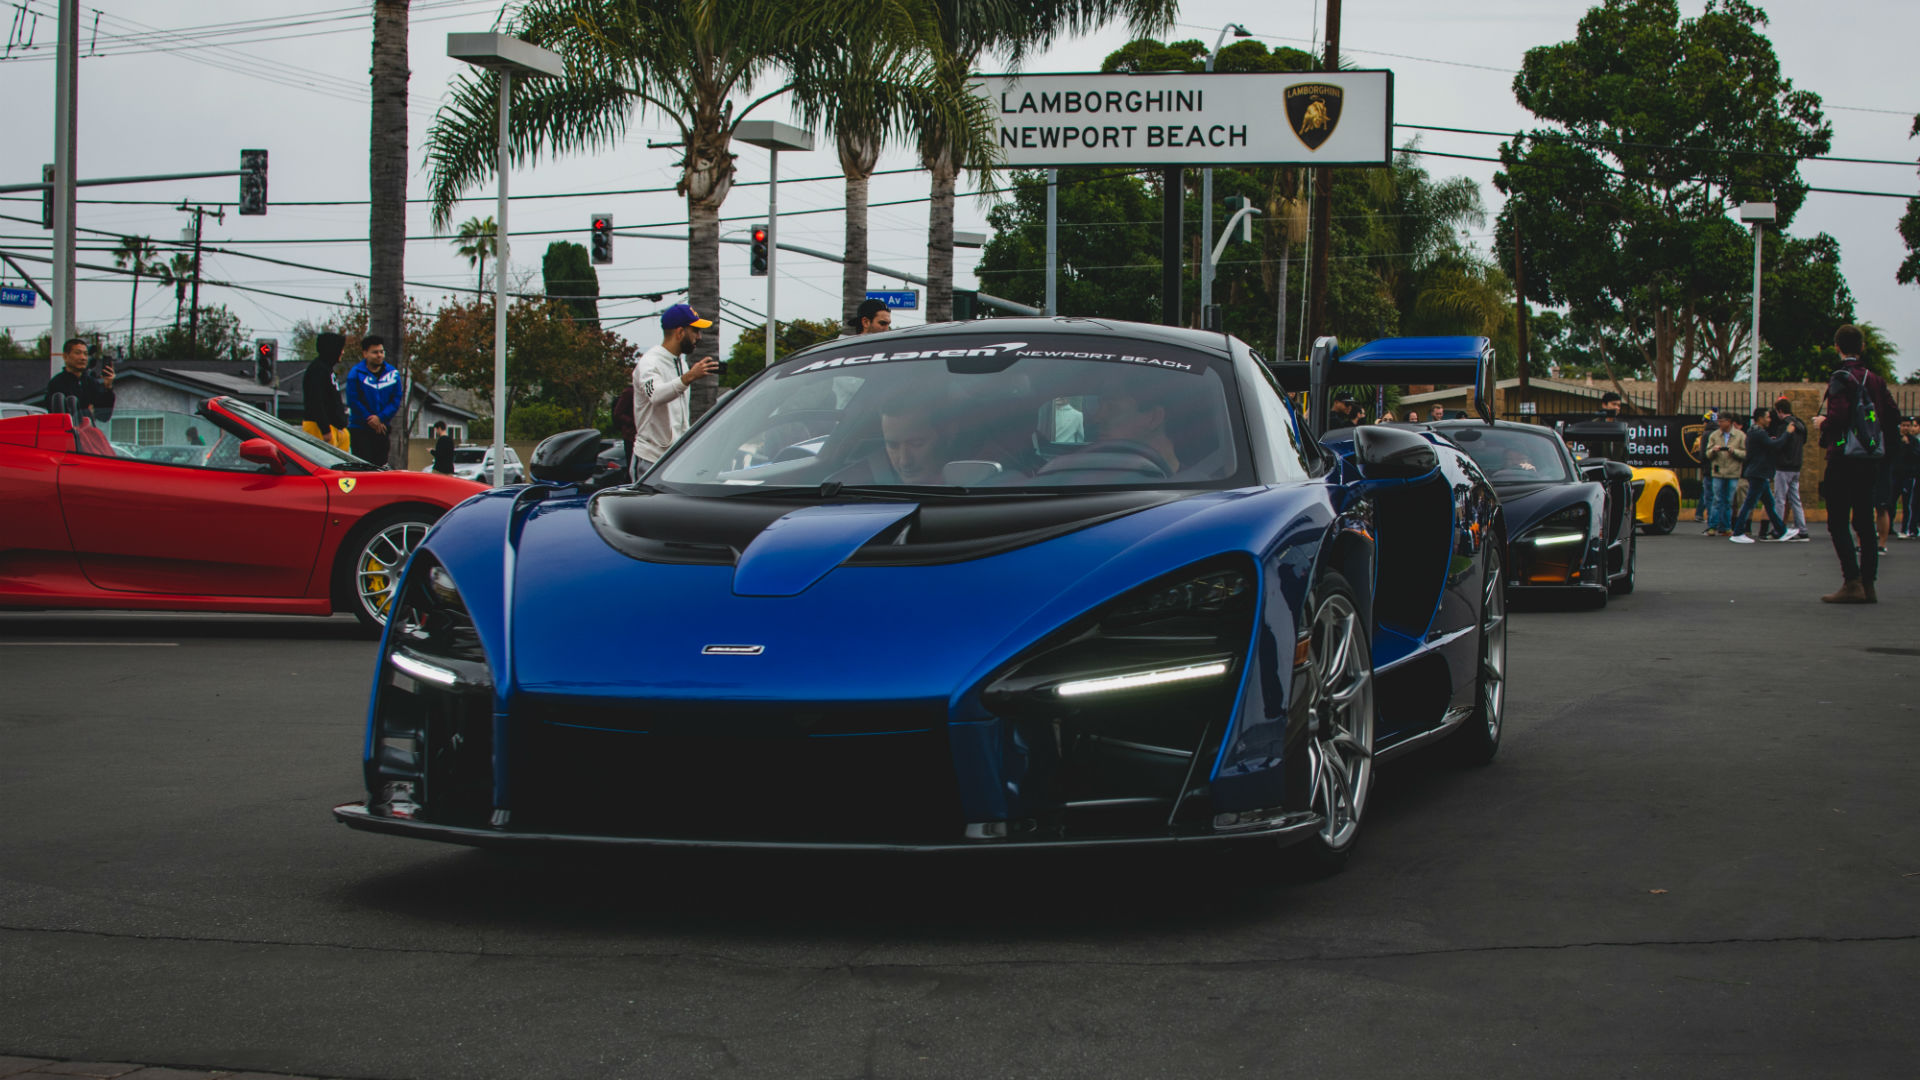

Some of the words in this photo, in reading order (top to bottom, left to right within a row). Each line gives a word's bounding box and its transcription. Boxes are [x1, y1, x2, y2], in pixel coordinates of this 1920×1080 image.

[1000, 90, 1203, 114] LAMBORGHINI
[1000, 126, 1138, 149] NEWPORT
[1147, 124, 1248, 148] BEACH
[888, 296, 901, 304] Av
[790, 348, 998, 375] McLaren
[1015, 350, 1118, 361] NEWPORT
[1120, 354, 1192, 370] BEACH
[1629, 425, 1667, 439] ghini
[1629, 442, 1669, 454] Beach
